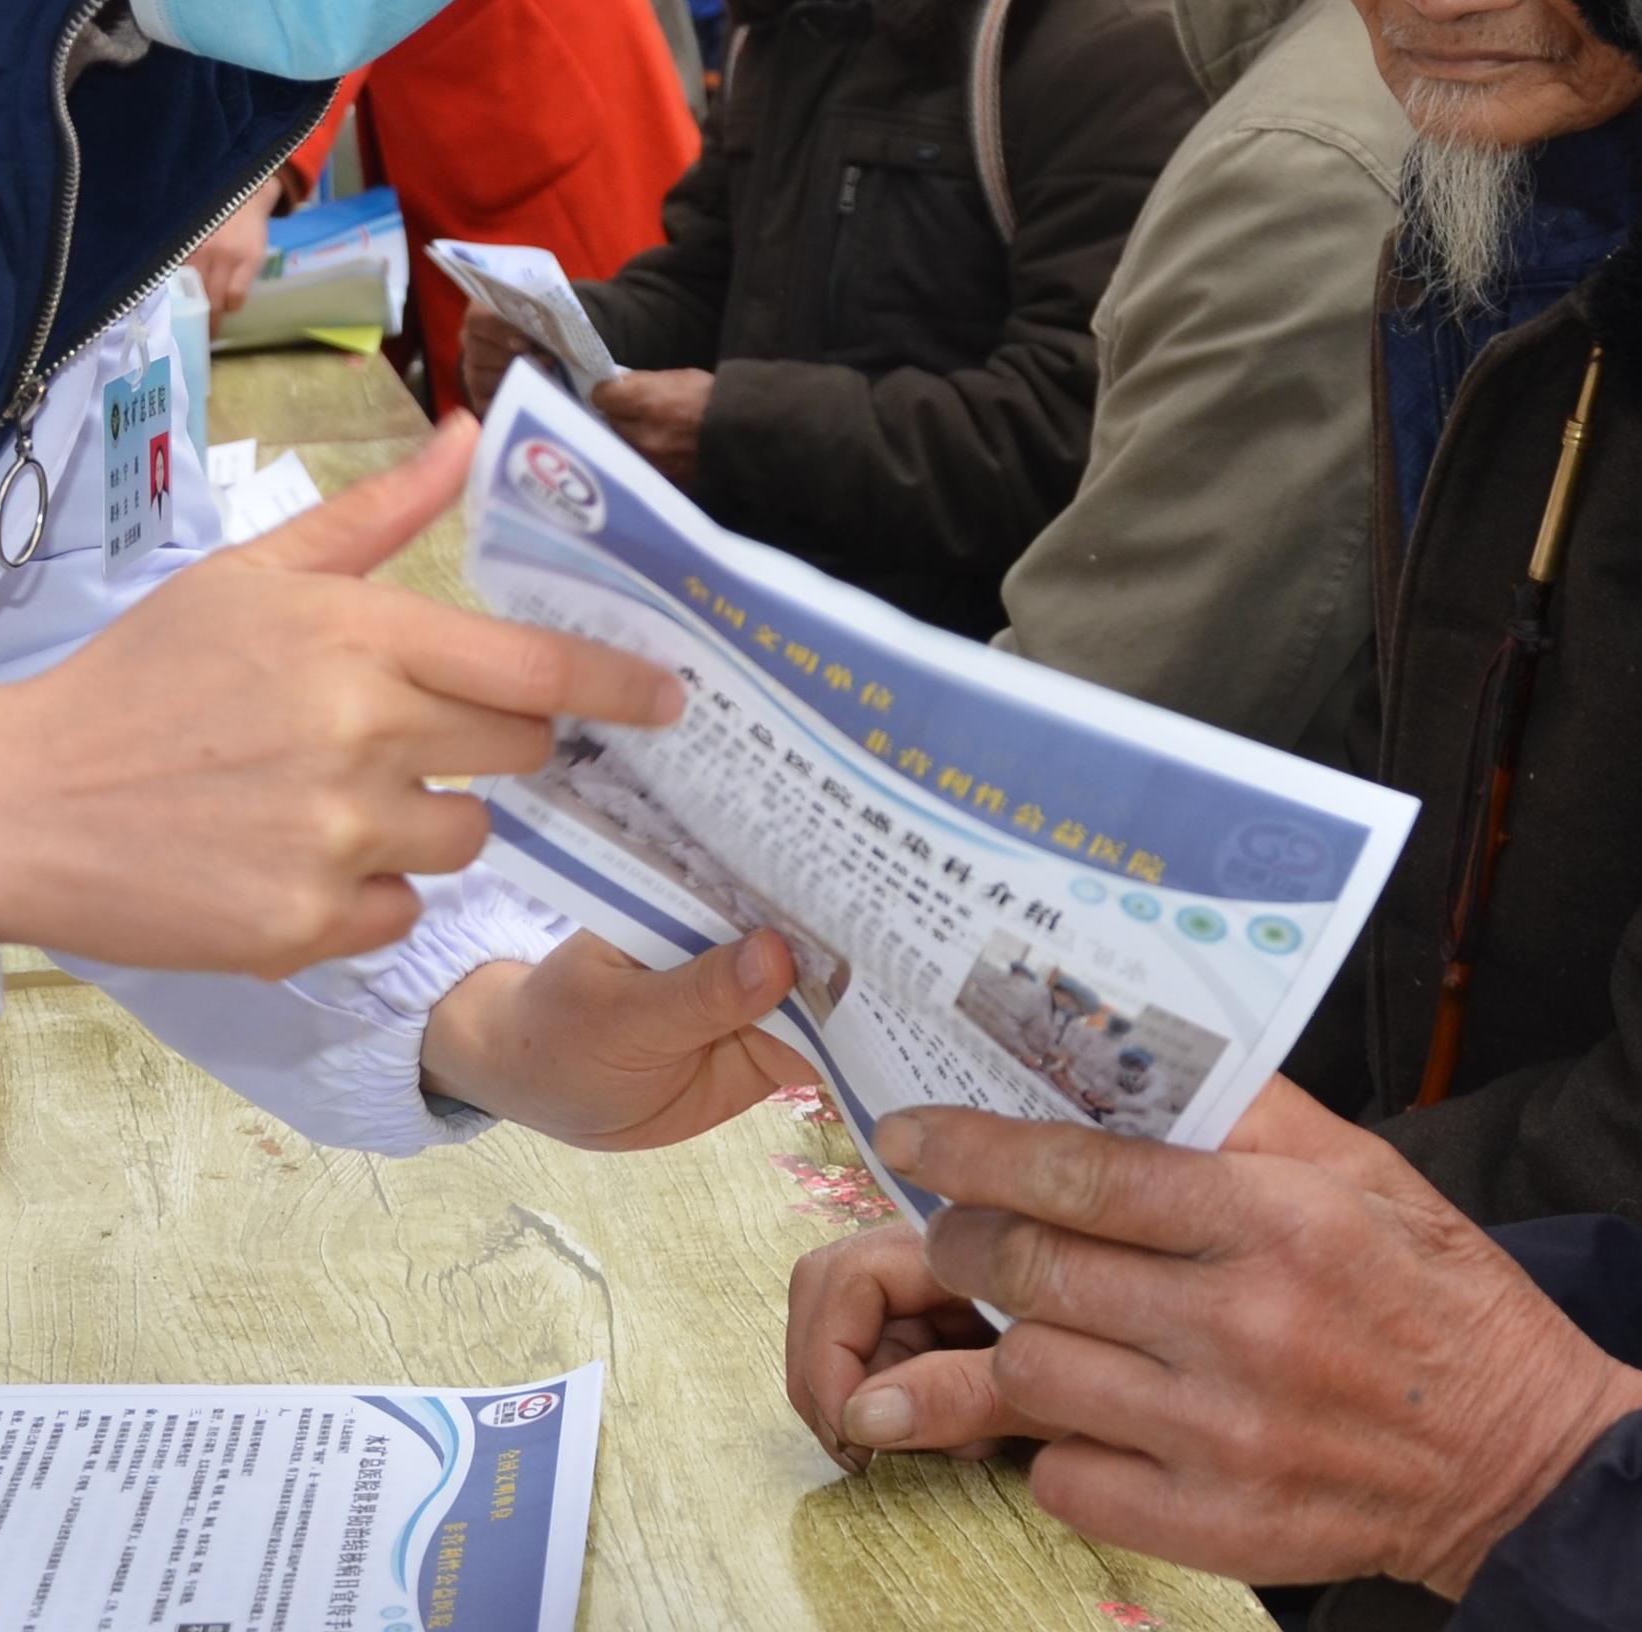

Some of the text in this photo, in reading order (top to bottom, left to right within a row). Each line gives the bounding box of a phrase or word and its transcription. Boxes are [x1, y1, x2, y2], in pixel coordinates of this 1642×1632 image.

[863, 727, 1169, 887] 非营利性公益医院
